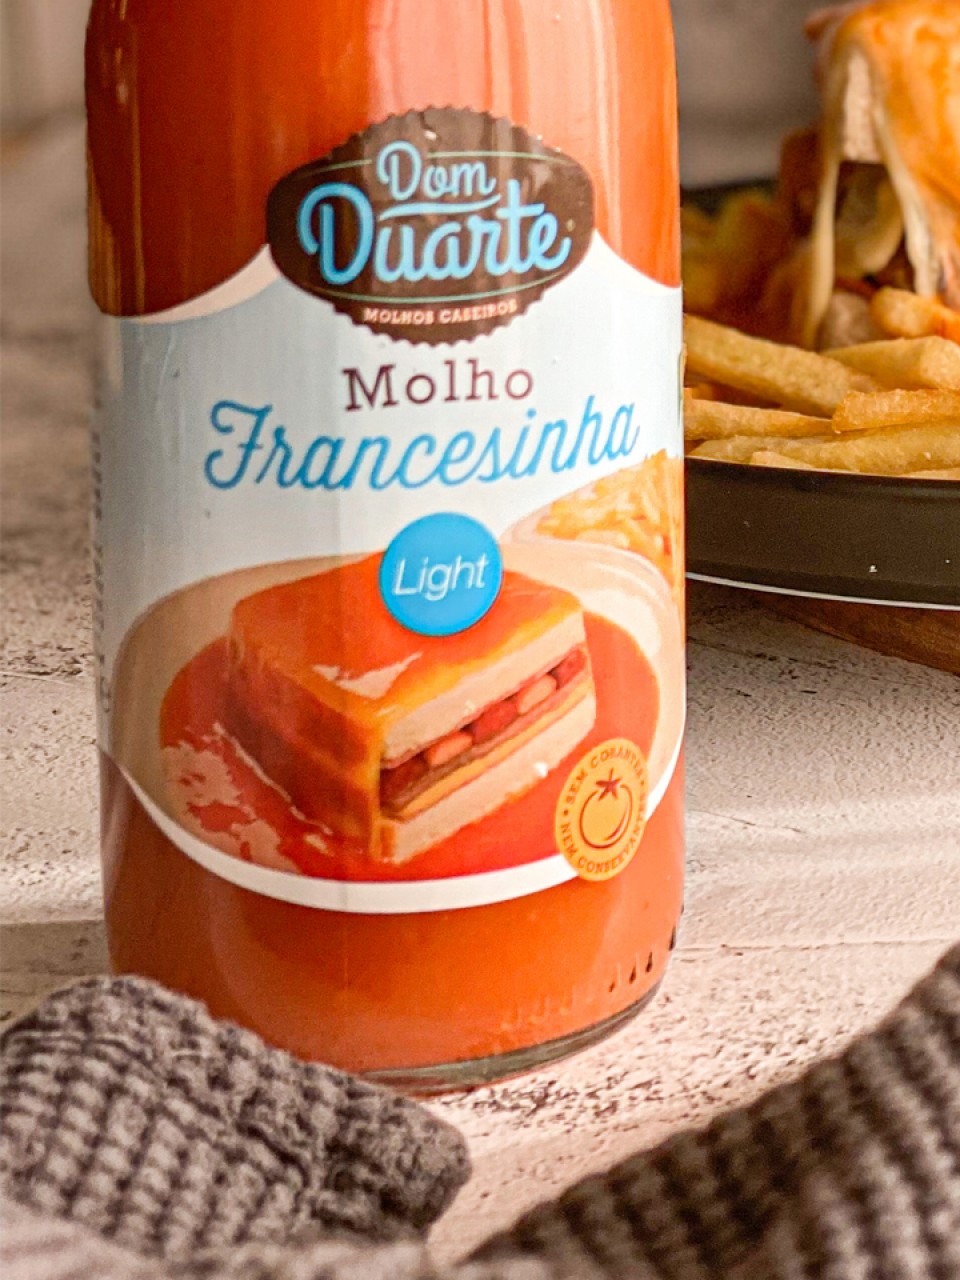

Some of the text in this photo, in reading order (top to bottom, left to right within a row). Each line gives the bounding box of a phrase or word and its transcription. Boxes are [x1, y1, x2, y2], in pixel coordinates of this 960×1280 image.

[376, 140, 497, 201] Dom
[297, 179, 572, 285] Duarte
[363, 298, 518, 325] MOLHOS CASEIROS
[342, 358, 534, 412] Molho
[203, 393, 641, 491] Francesinha
[391, 552, 490, 601] Light
